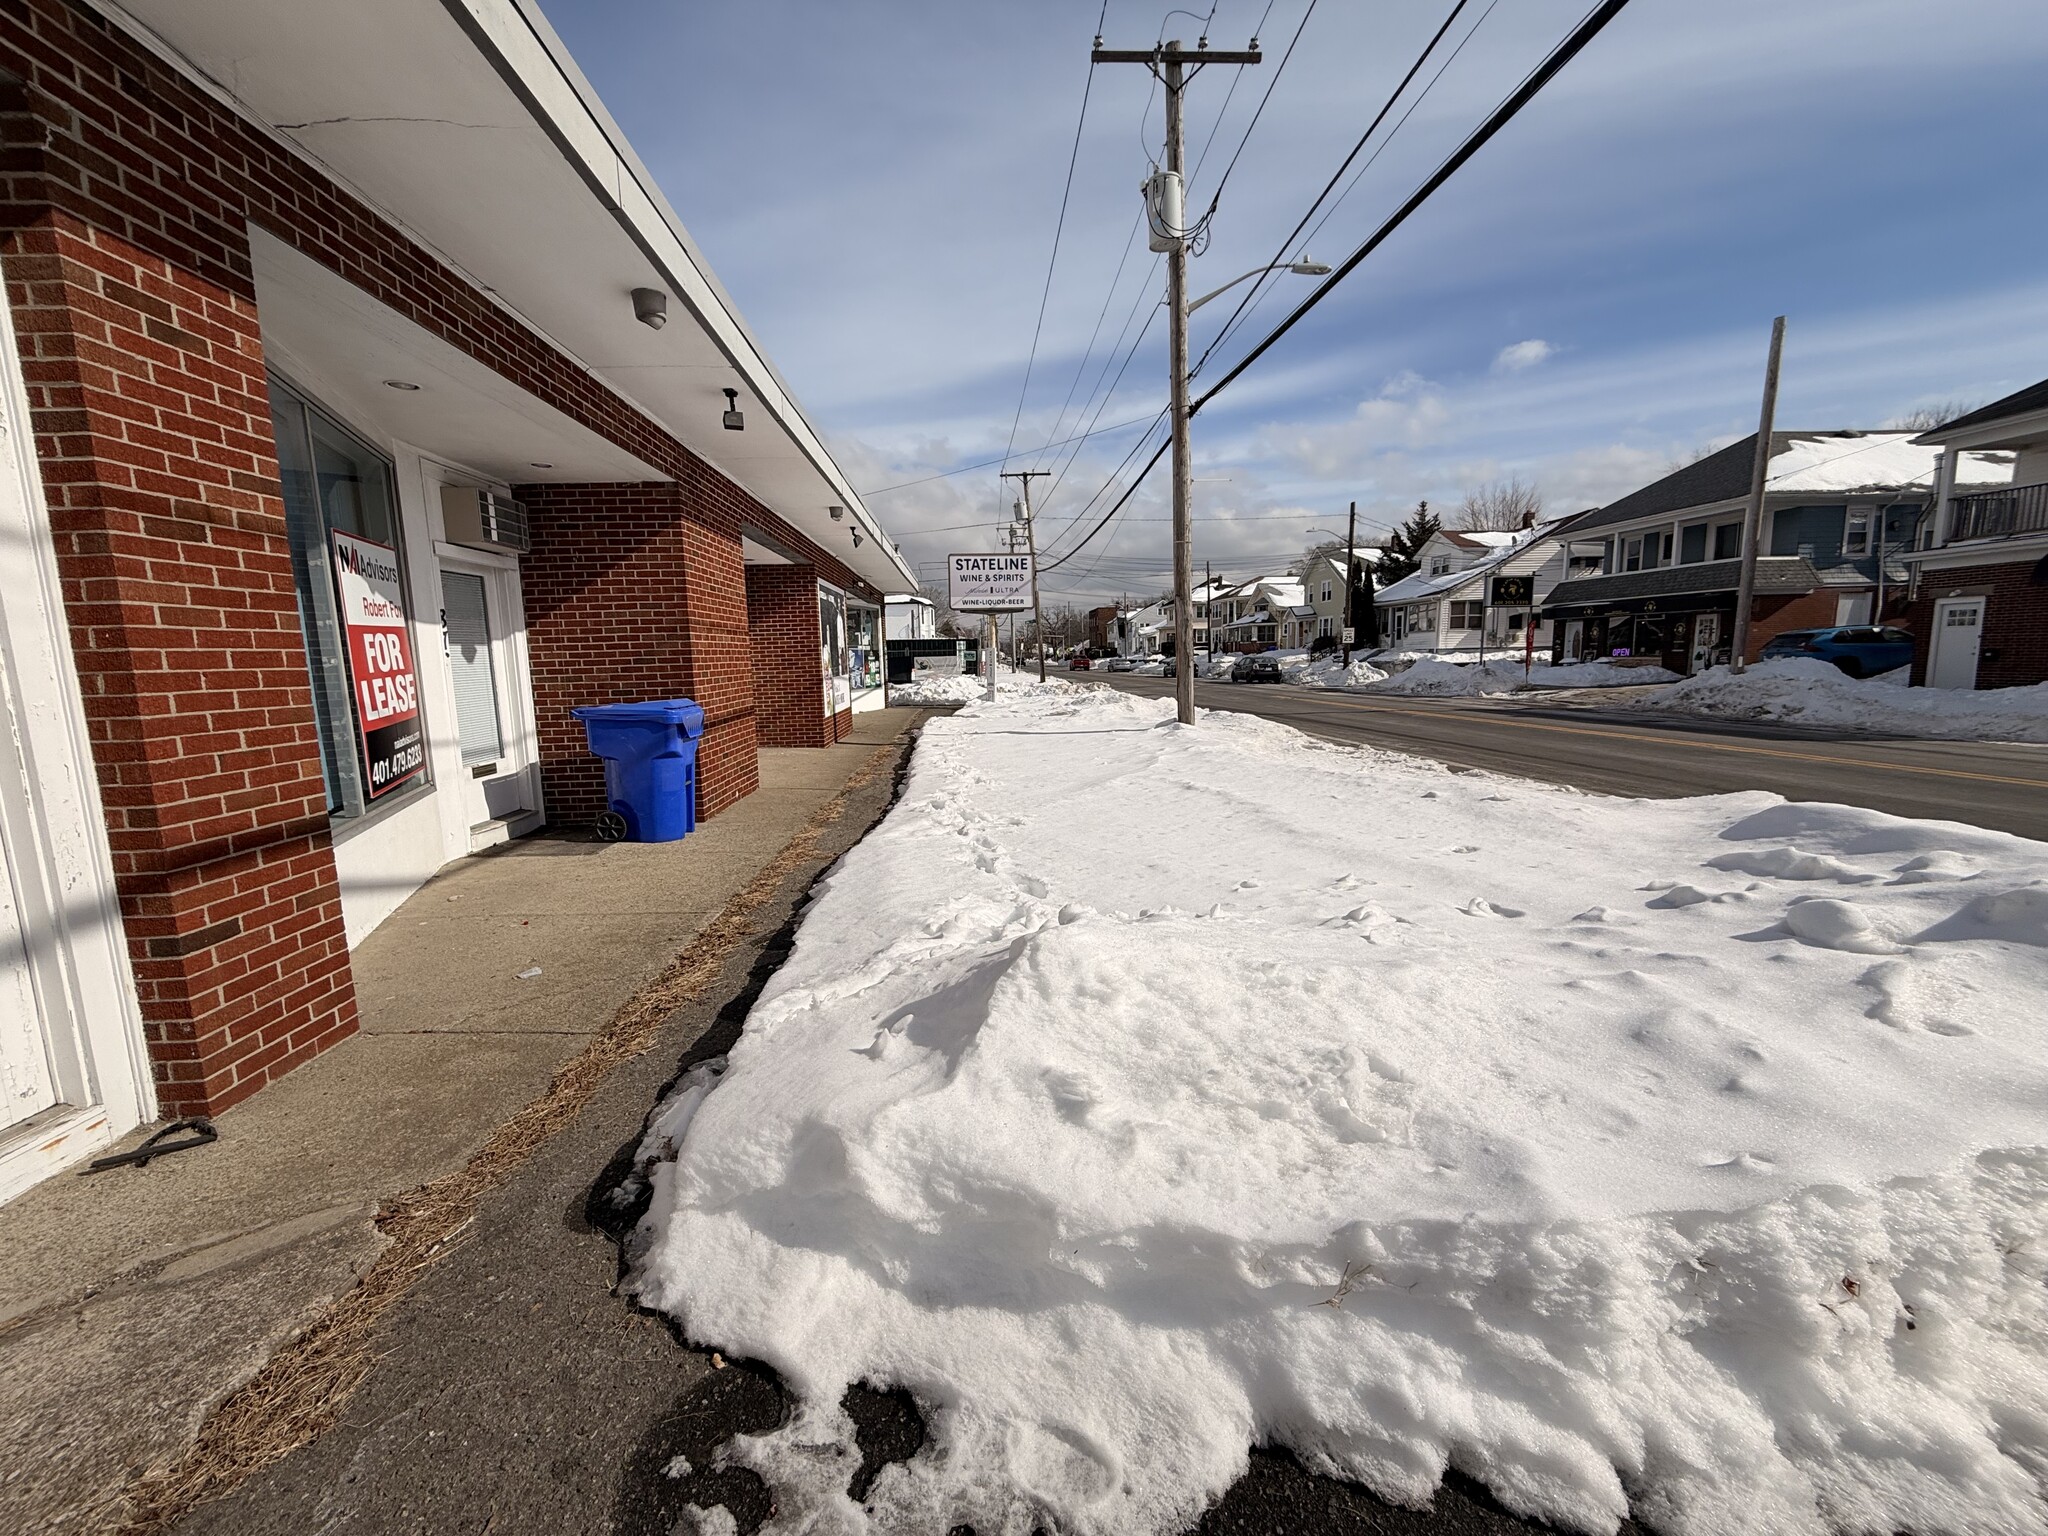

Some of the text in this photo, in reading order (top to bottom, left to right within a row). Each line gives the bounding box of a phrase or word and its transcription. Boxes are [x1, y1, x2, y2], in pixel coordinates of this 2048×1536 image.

[338, 541, 398, 584] NAI Advisors
[955, 558, 1028, 571] STATELINE
[960, 574, 1025, 582] WINE & SPIRITS
[995, 586, 1020, 594] ULTRA
[362, 597, 390, 618] Robert
[363, 633, 405, 674] FOR
[1612, 647, 1631, 657] OPEN
[361, 673, 417, 721] LEASE
